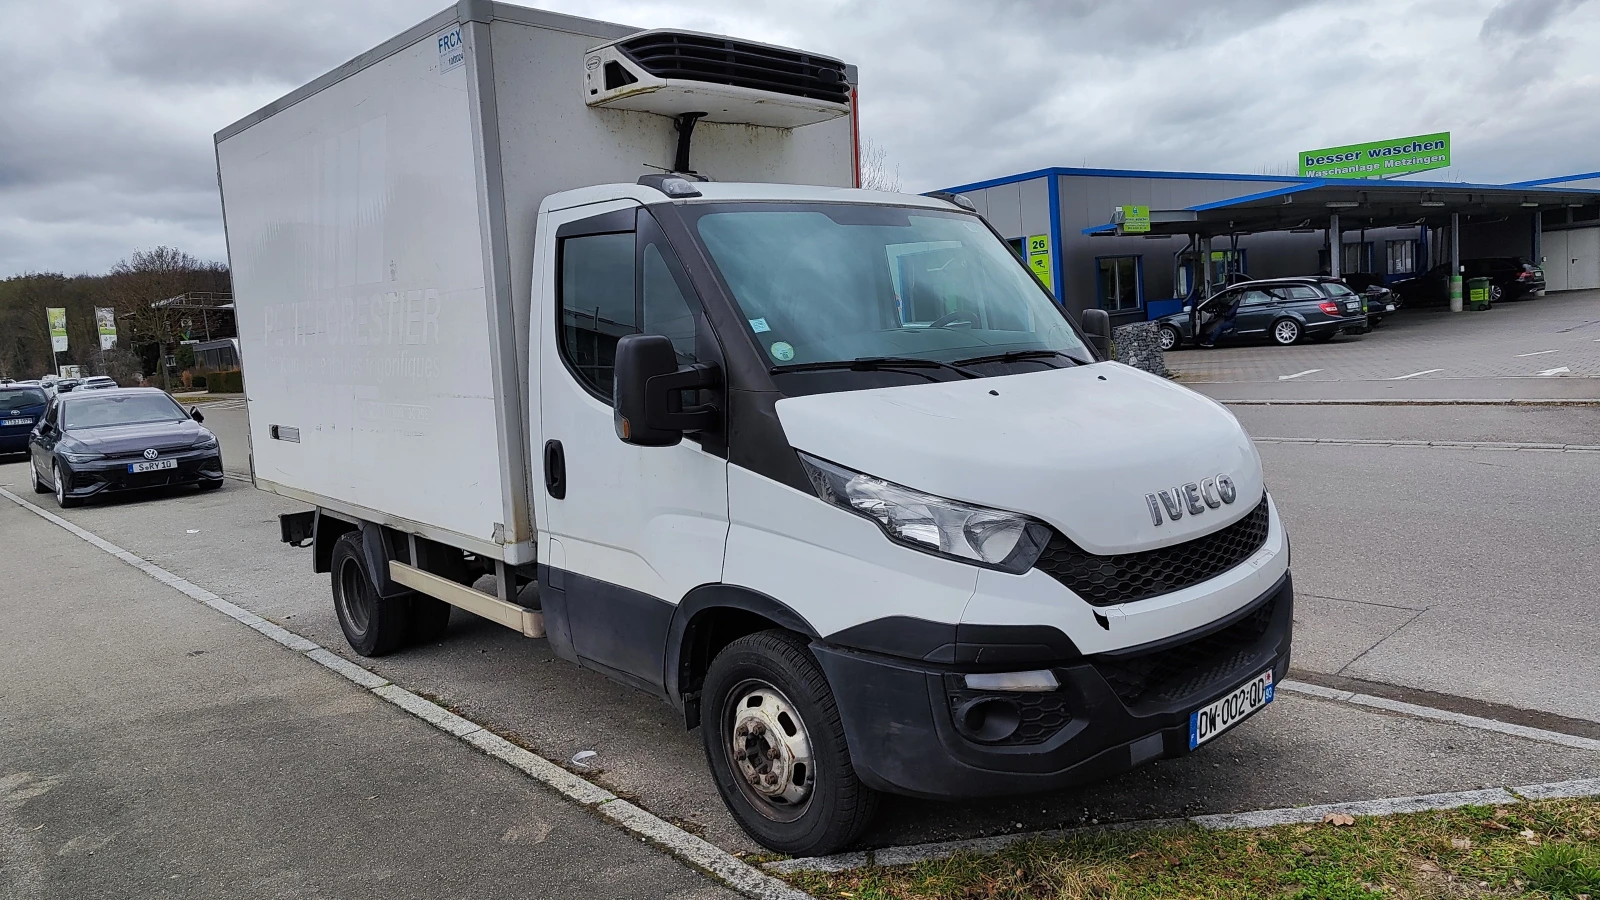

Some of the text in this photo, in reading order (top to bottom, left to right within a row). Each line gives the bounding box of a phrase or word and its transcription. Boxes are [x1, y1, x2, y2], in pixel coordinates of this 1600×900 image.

[438, 28, 462, 54] FRCX
[1305, 139, 1445, 167] besser waschen
[1305, 154, 1446, 178] Waschanlage Metzingen
[1032, 240, 1045, 250] 26
[314, 288, 441, 347] FORESTIER
[1145, 473, 1237, 526] IVECO
